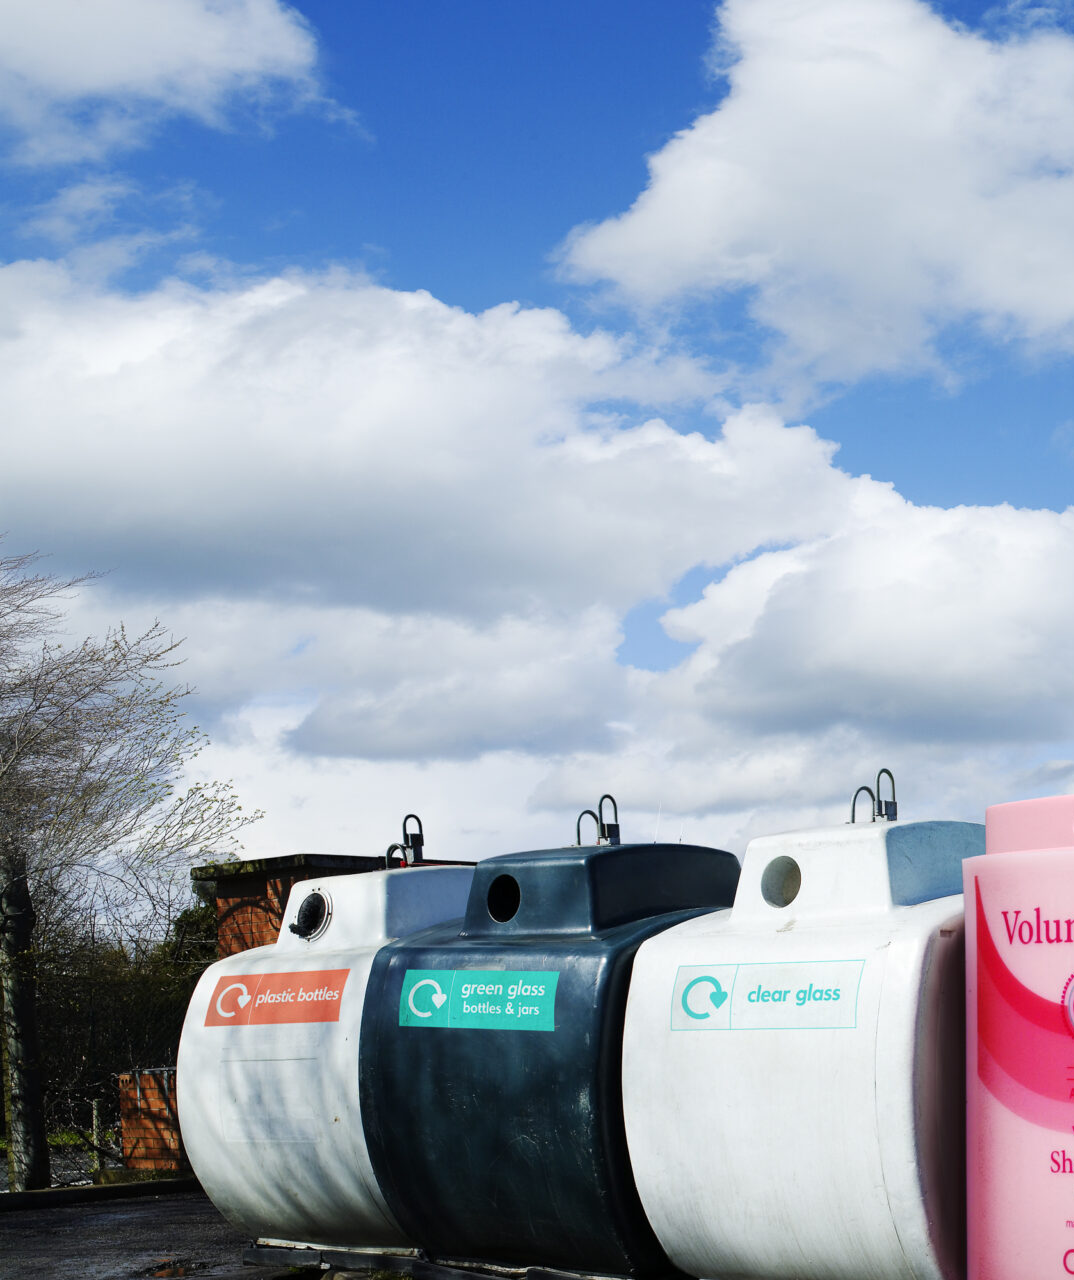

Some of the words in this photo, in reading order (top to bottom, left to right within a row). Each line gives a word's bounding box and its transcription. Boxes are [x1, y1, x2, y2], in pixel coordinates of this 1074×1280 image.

[255, 988, 296, 1006] plastic
[297, 986, 340, 1004] bottles
[461, 979, 503, 999] green
[507, 978, 546, 997] glass
[747, 985, 791, 1003] clear
[795, 983, 841, 1006] glass
[462, 1001, 501, 1015] bottles
[505, 1002, 514, 1015] &
[517, 1002, 540, 1018] jars
